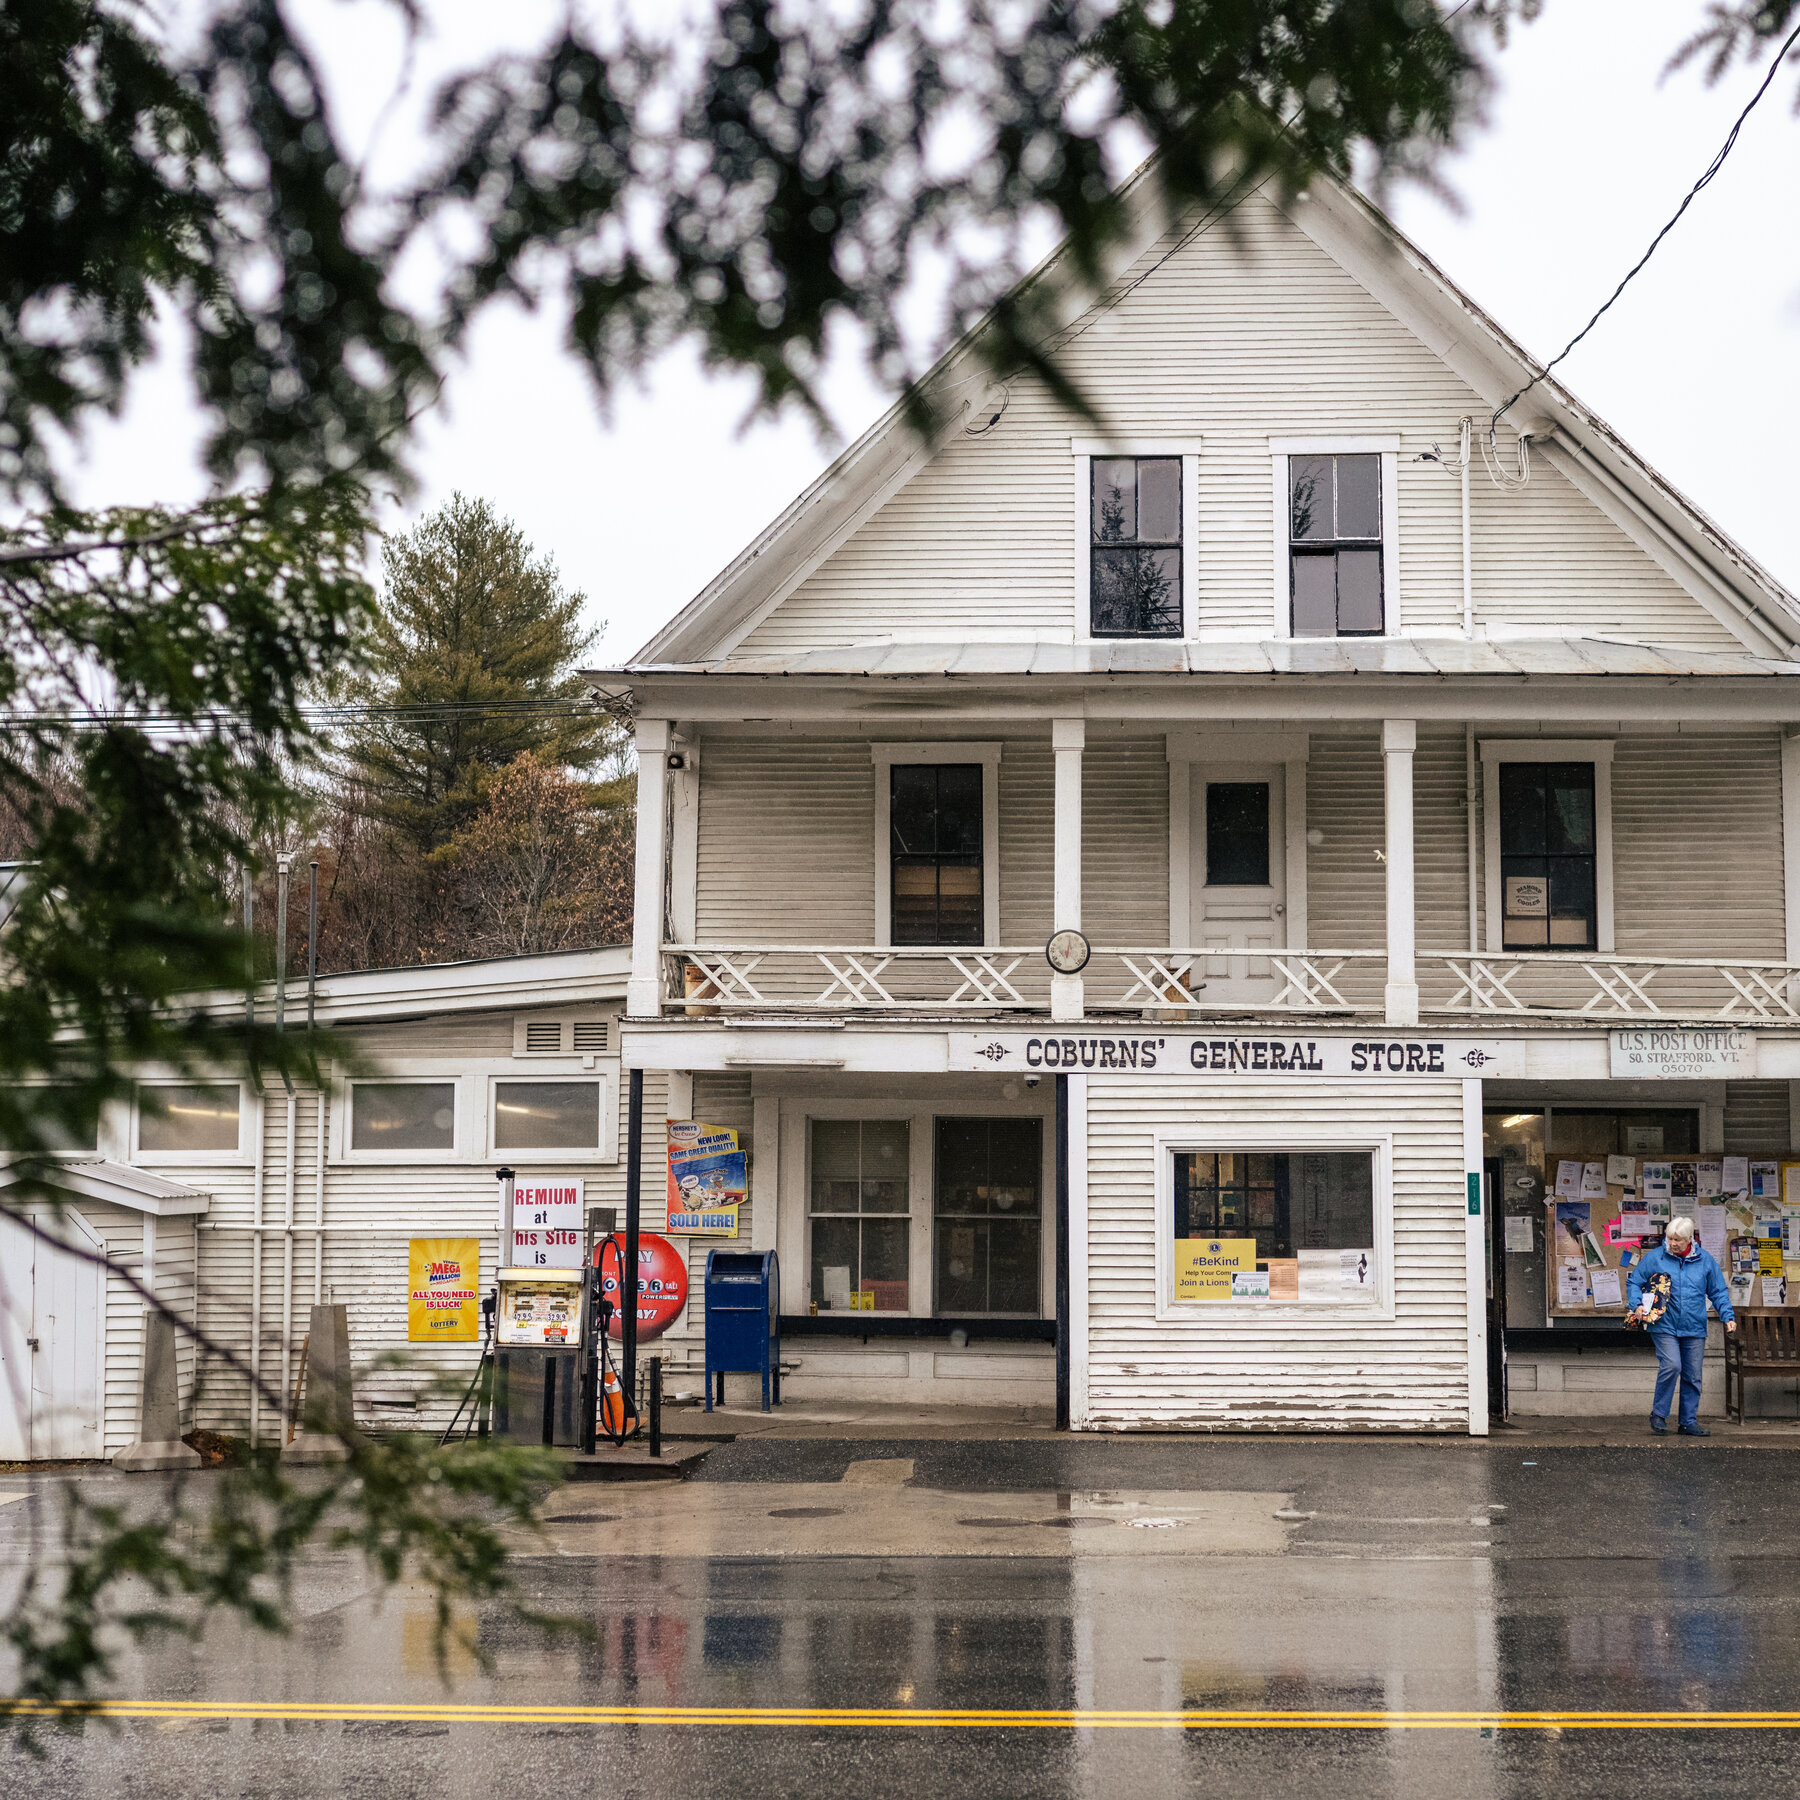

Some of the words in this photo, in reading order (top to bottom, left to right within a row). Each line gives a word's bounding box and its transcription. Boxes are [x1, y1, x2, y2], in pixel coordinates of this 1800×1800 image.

[1619, 1033, 1647, 1050] U.S.
[1650, 1033, 1688, 1050] POST
[1693, 1032, 1747, 1050] OFFICE
[1026, 1038, 1165, 1068] COBURNS'
[1190, 1040, 1323, 1070] GENERAL
[1351, 1042, 1444, 1072] STORE
[1629, 1053, 1643, 1063] SO.
[1720, 1052, 1739, 1062] VT.
[1661, 1064, 1703, 1073] 05070
[697, 1135, 712, 1145] NEW
[712, 1133, 731, 1143] LOOK!
[669, 1150, 687, 1160] SAME
[688, 1146, 707, 1157] GREAT
[708, 1142, 736, 1153] QUALITY!
[515, 1188, 577, 1205] REMIUM
[534, 1210, 548, 1224] at
[669, 1213, 699, 1228] SOLD
[701, 1213, 735, 1228] HERE!
[515, 1230, 538, 1245] his
[545, 1230, 577, 1245] Site
[535, 1251, 547, 1264] is
[614, 1250, 653, 1263] PAY
[1192, 1256, 1239, 1266] #BeKind
[431, 1262, 461, 1275] MEGA
[1179, 1279, 1197, 1287] Join
[1206, 1279, 1229, 1287] Lions
[412, 1291, 429, 1299] ALL
[430, 1320, 458, 1328] LOTTERY
